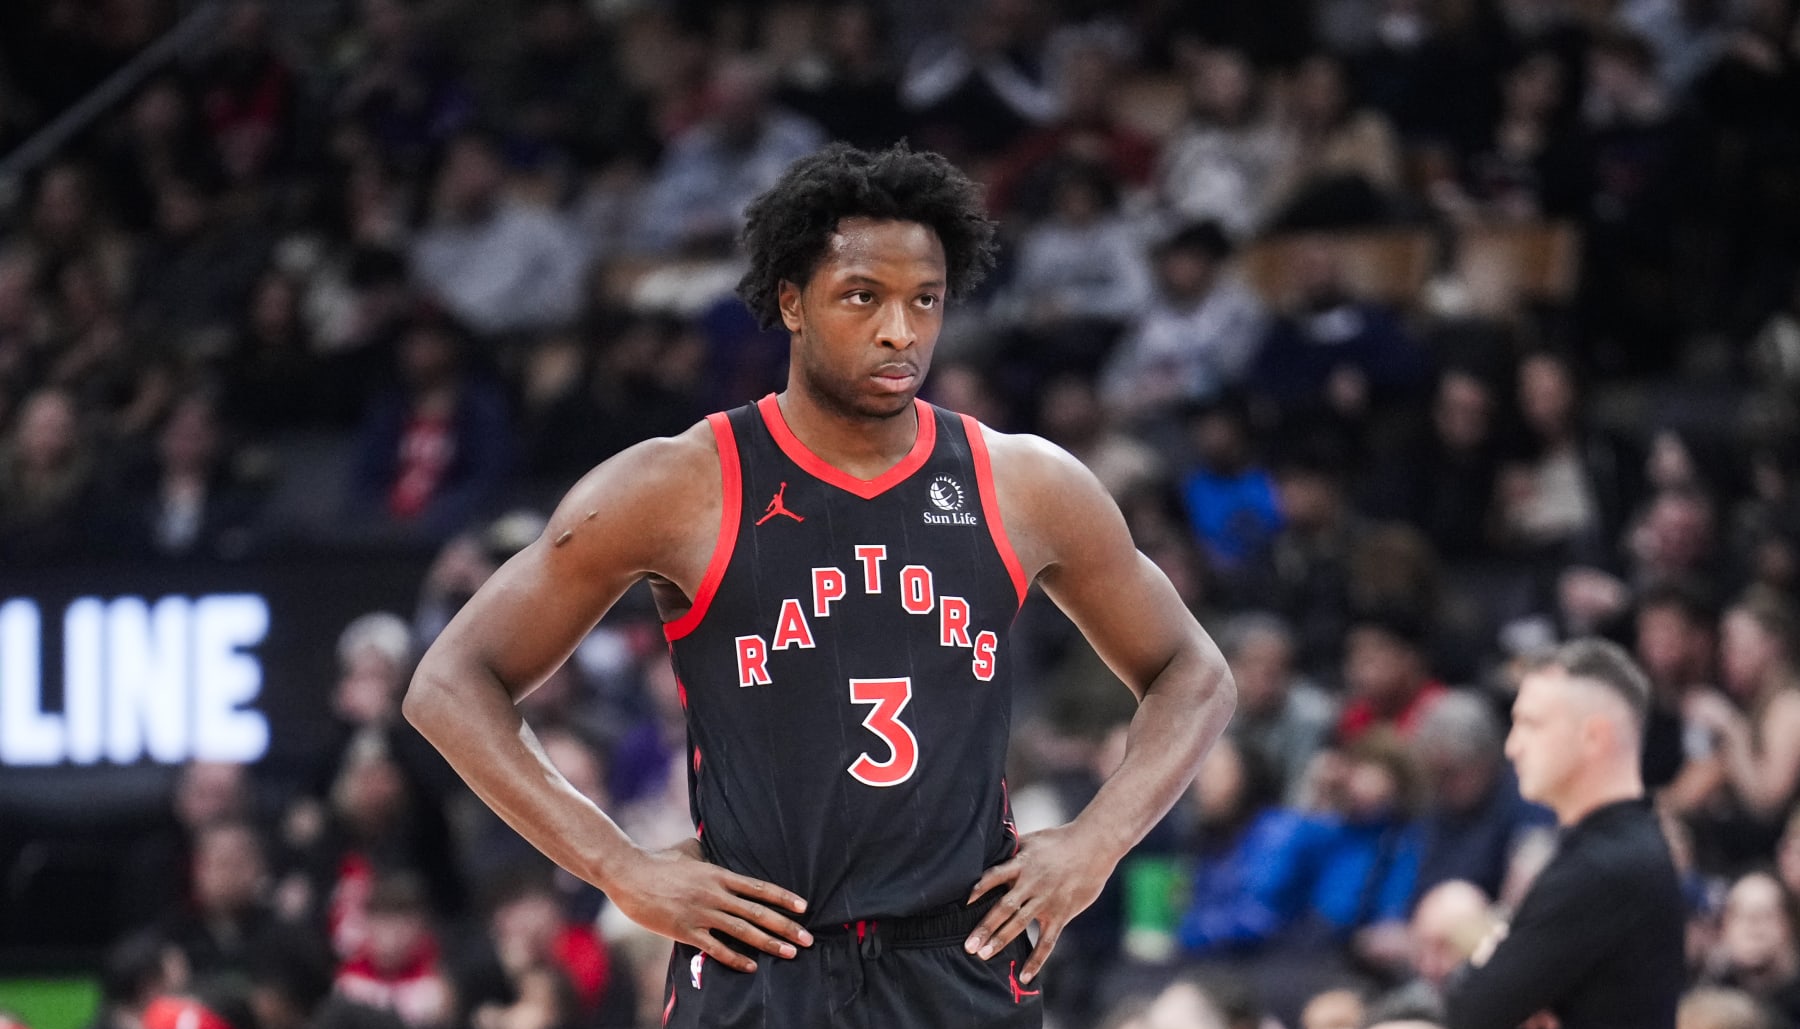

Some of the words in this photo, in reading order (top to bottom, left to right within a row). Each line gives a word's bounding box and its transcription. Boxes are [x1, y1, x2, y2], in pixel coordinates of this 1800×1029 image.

[923, 511, 950, 524] Sun
[952, 512, 977, 525] Life
[0, 594, 271, 765] LINE
[735, 544, 998, 688] RAPTORS
[847, 677, 919, 787] 3
